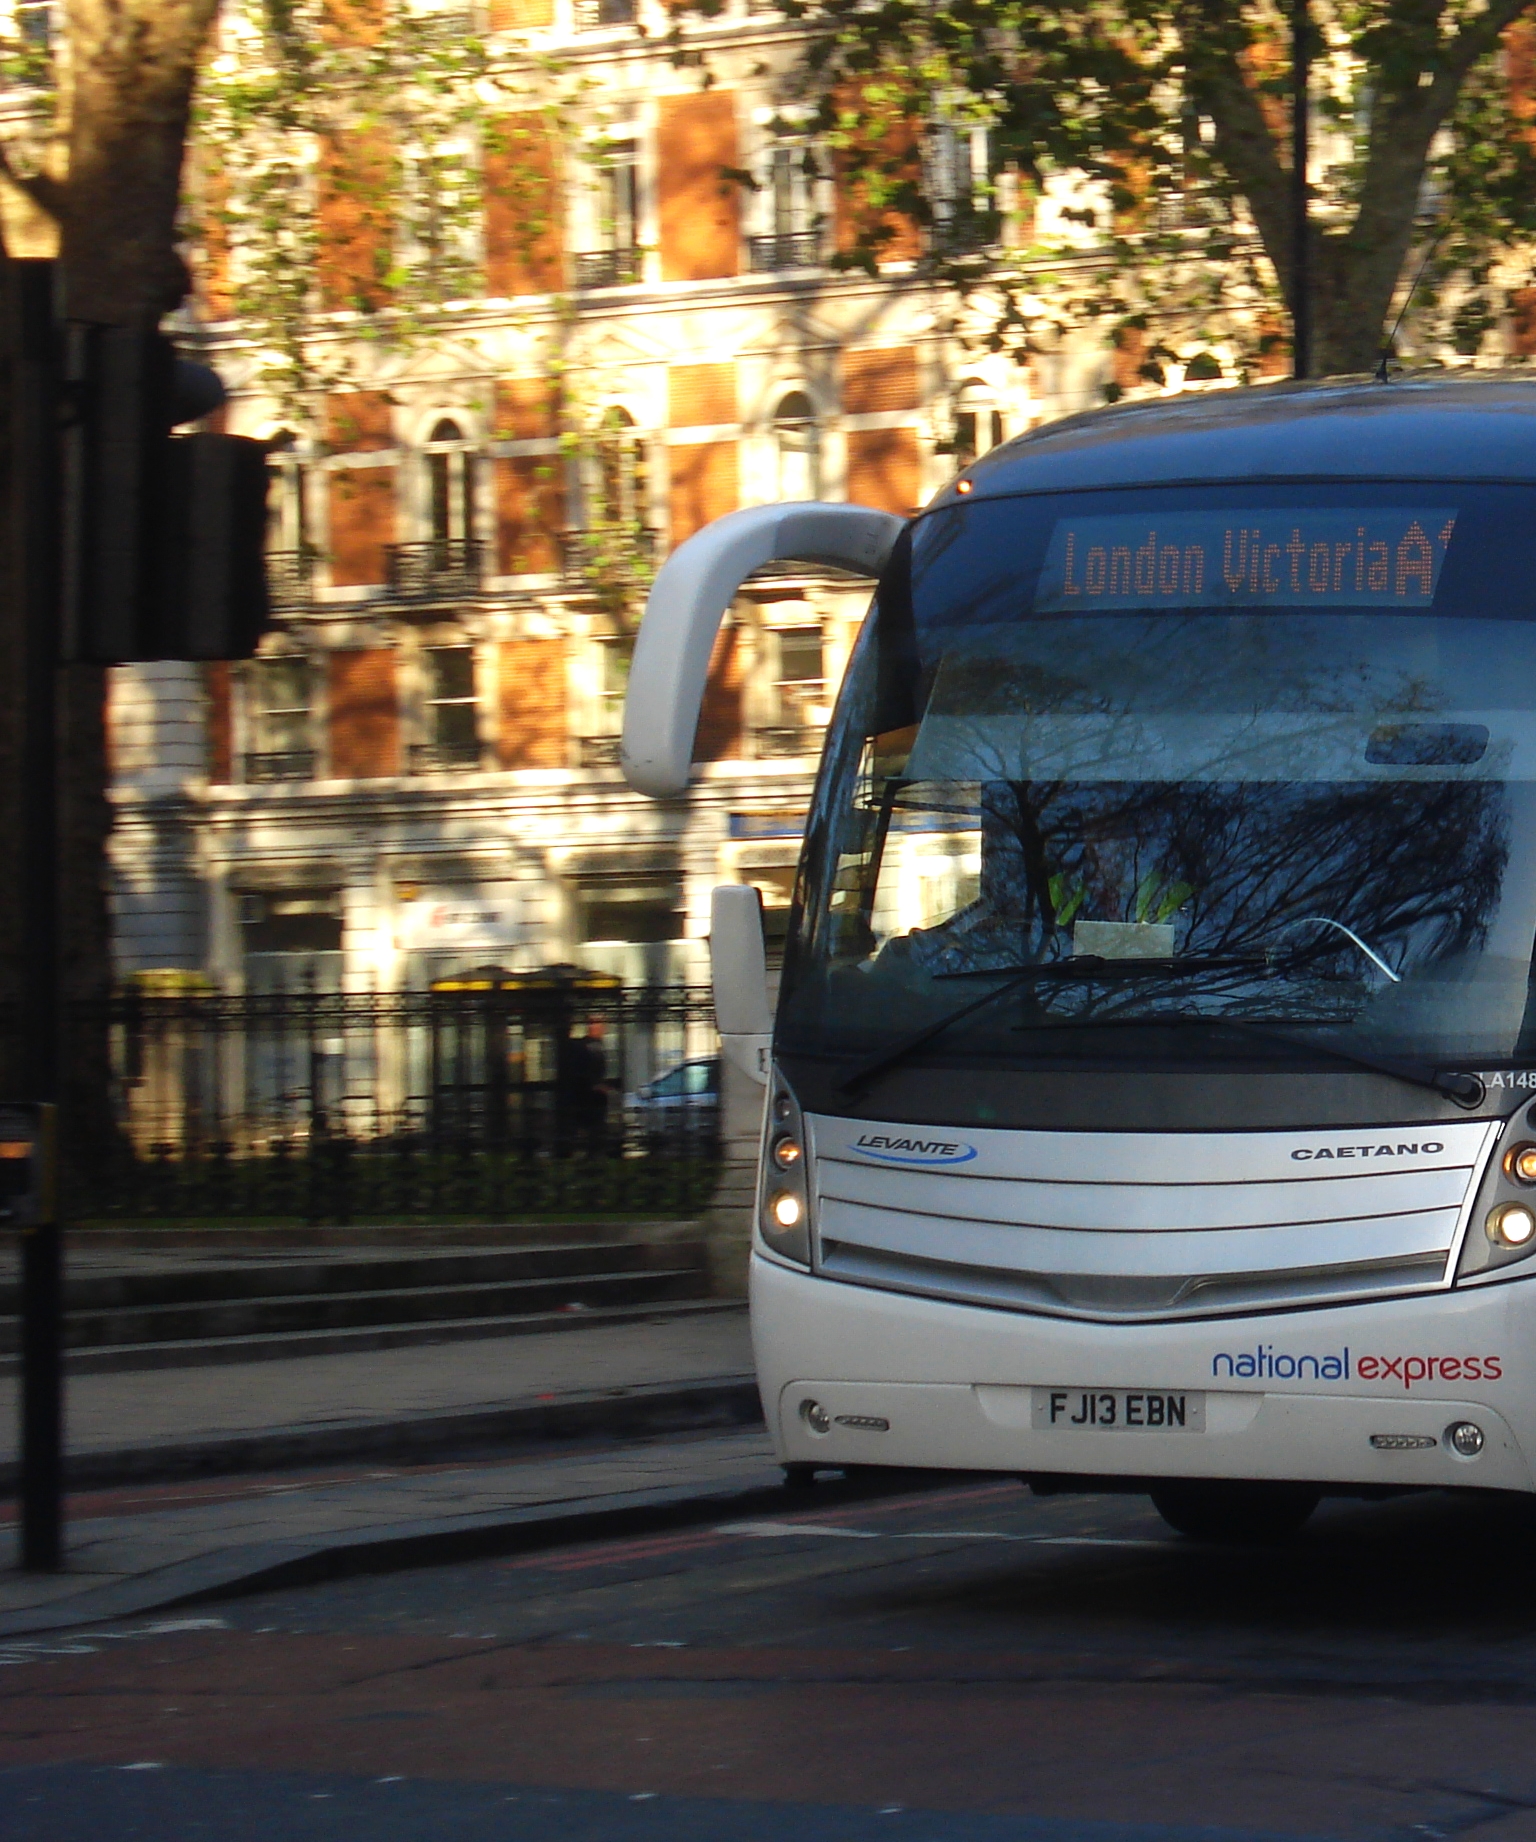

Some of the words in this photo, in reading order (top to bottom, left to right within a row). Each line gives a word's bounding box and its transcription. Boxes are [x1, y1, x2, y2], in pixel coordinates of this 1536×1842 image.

[1063, 530, 1204, 596] London
[1222, 526, 1389, 595] Victoria
[856, 1134, 959, 1156] LEVANTE
[1290, 1141, 1445, 1161] CAETANO
[1212, 1345, 1349, 1381] national
[1357, 1355, 1503, 1390] express
[1049, 1393, 1116, 1425] FJ13
[1126, 1396, 1186, 1427] EBN
